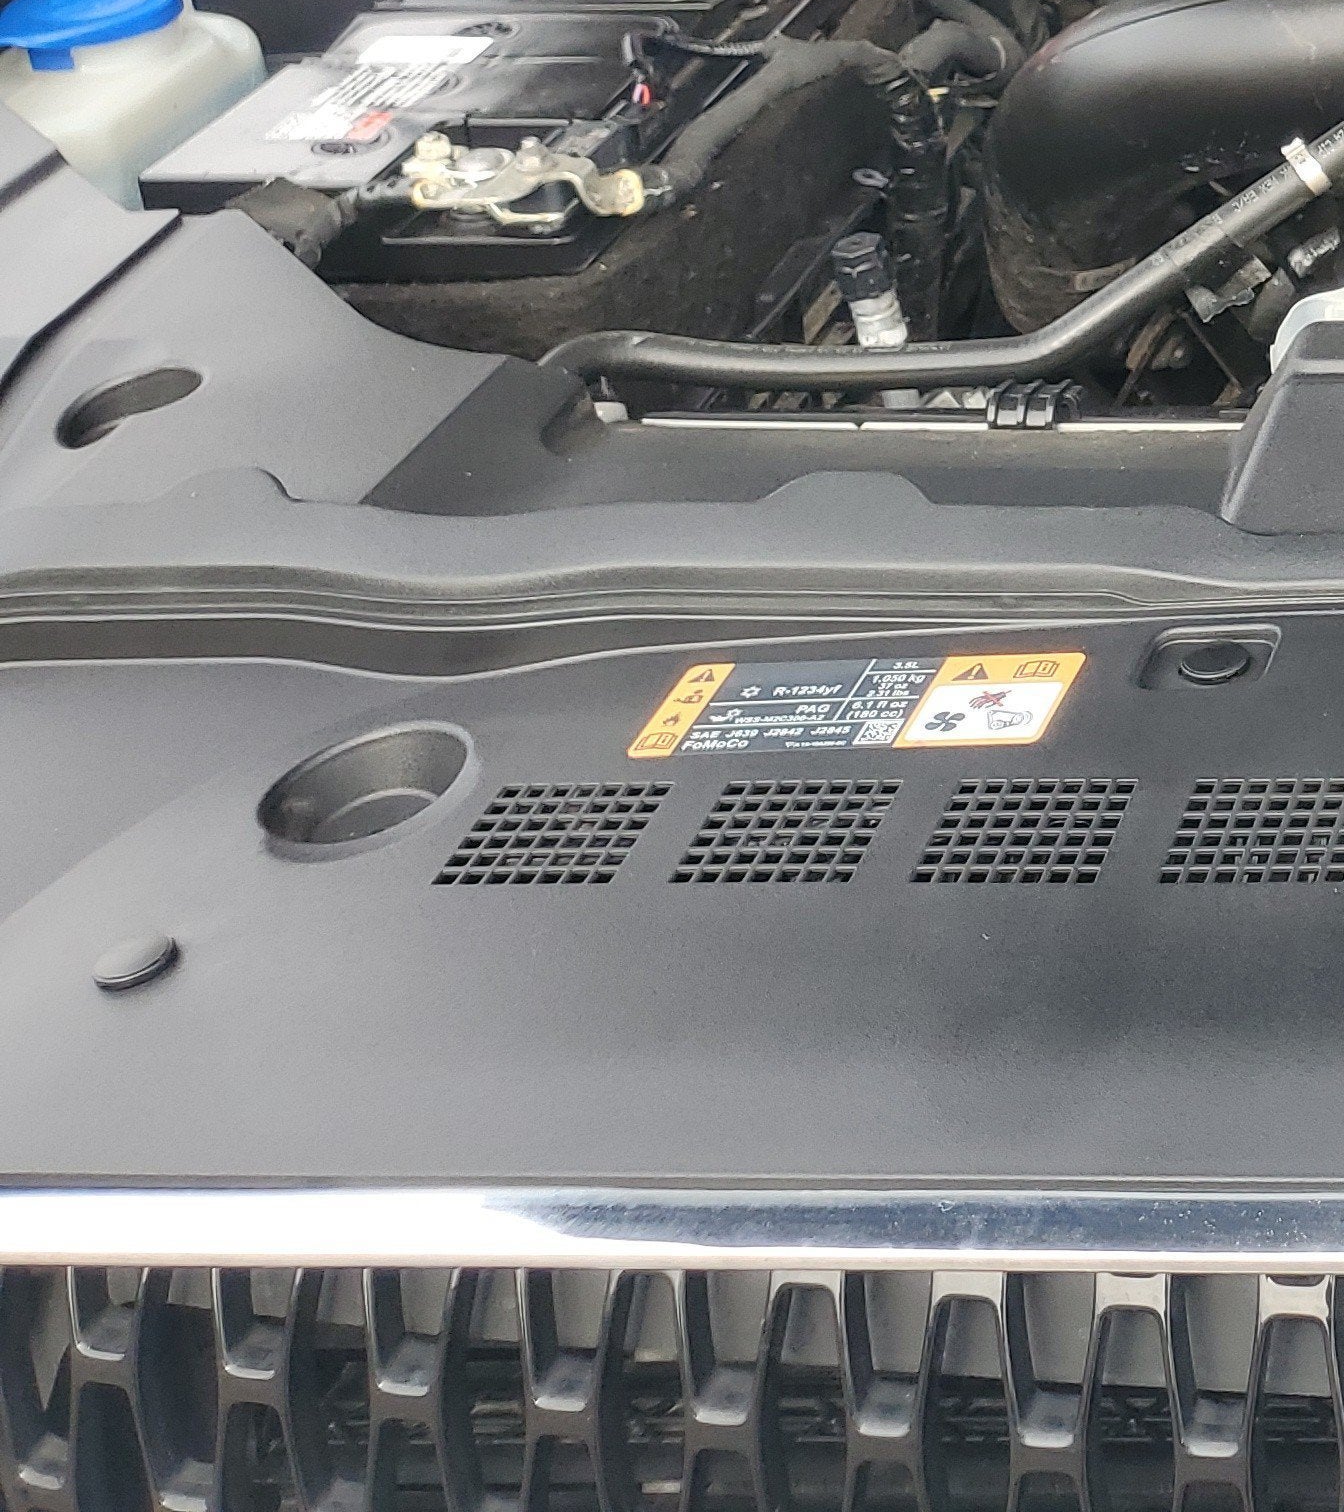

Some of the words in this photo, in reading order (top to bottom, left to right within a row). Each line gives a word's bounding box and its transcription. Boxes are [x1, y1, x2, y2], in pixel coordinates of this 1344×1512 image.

[872, 674, 907, 684] 1.050
[908, 674, 926, 684] kg
[852, 700, 874, 709] 6.1
[846, 710, 878, 720] (180
[880, 709, 904, 719] cc)
[690, 730, 722, 740] SAE
[724, 729, 759, 738] J639
[680, 738, 750, 751] FoMoCo
